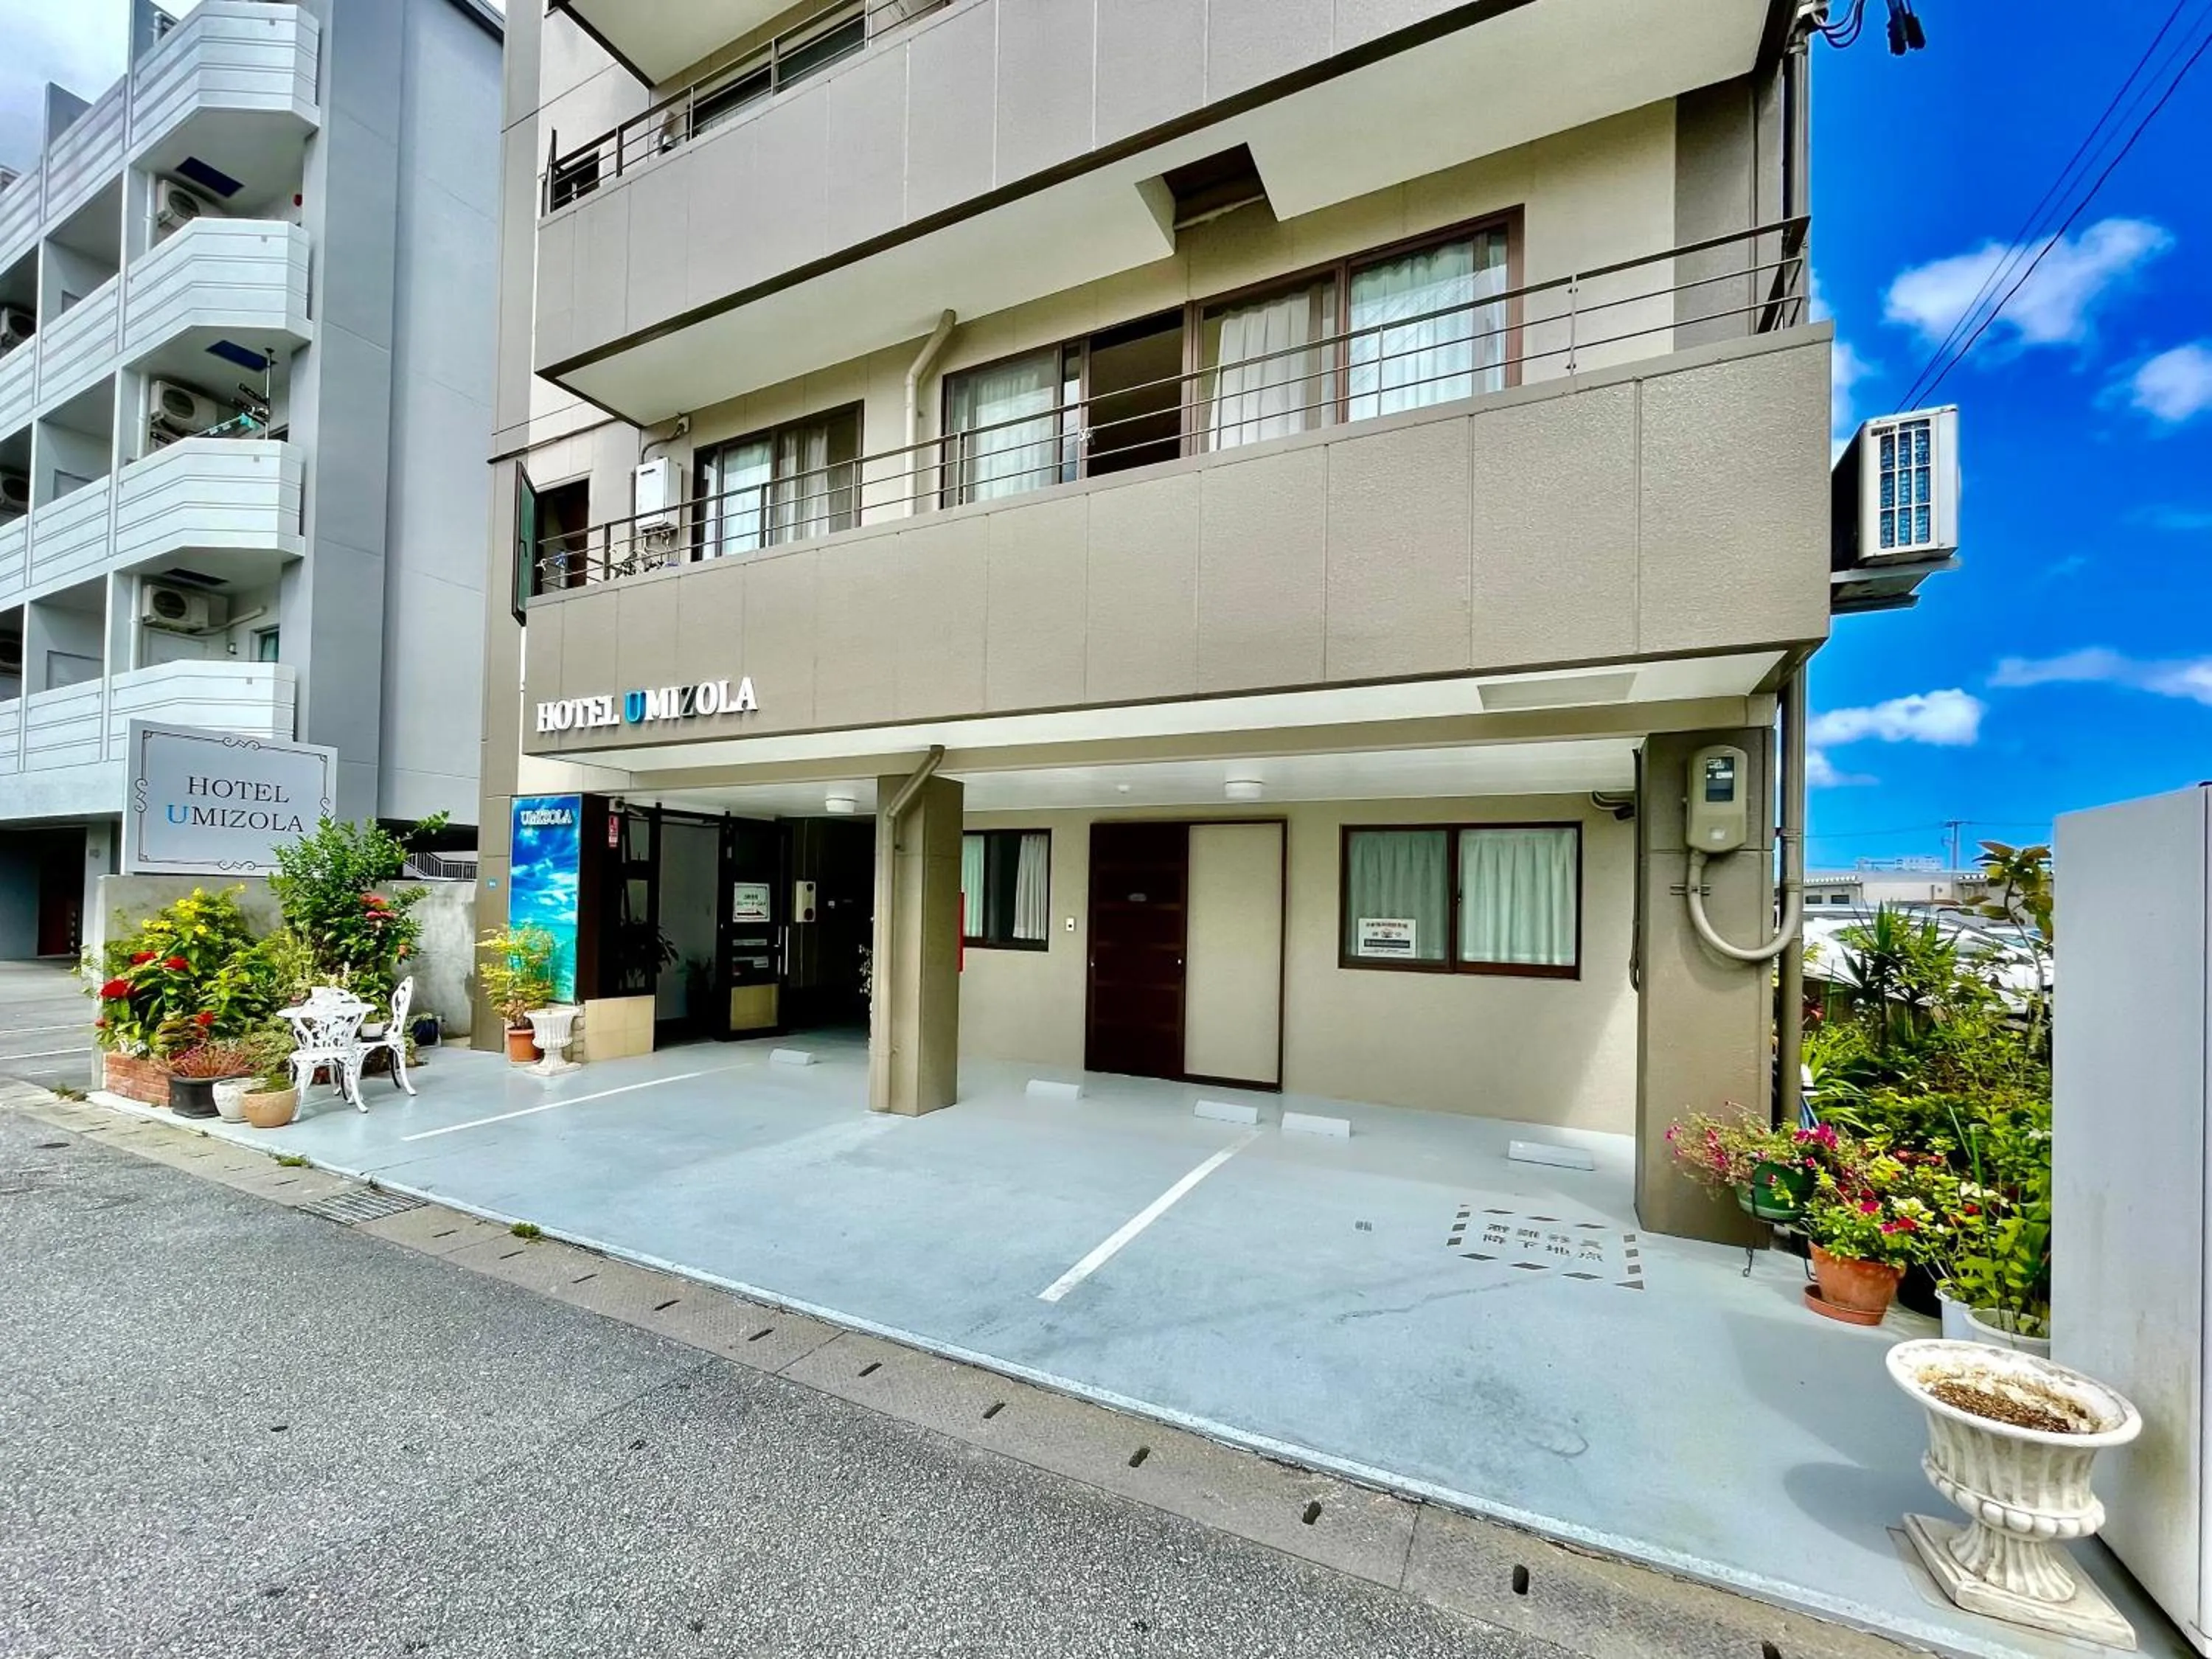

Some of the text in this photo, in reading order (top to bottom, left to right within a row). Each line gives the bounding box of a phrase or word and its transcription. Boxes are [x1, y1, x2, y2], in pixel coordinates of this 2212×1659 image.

[536, 676, 759, 732] HOTEL UMIZOLA
[187, 776, 290, 803] HOTEL
[167, 804, 304, 832] UMIZOLA
